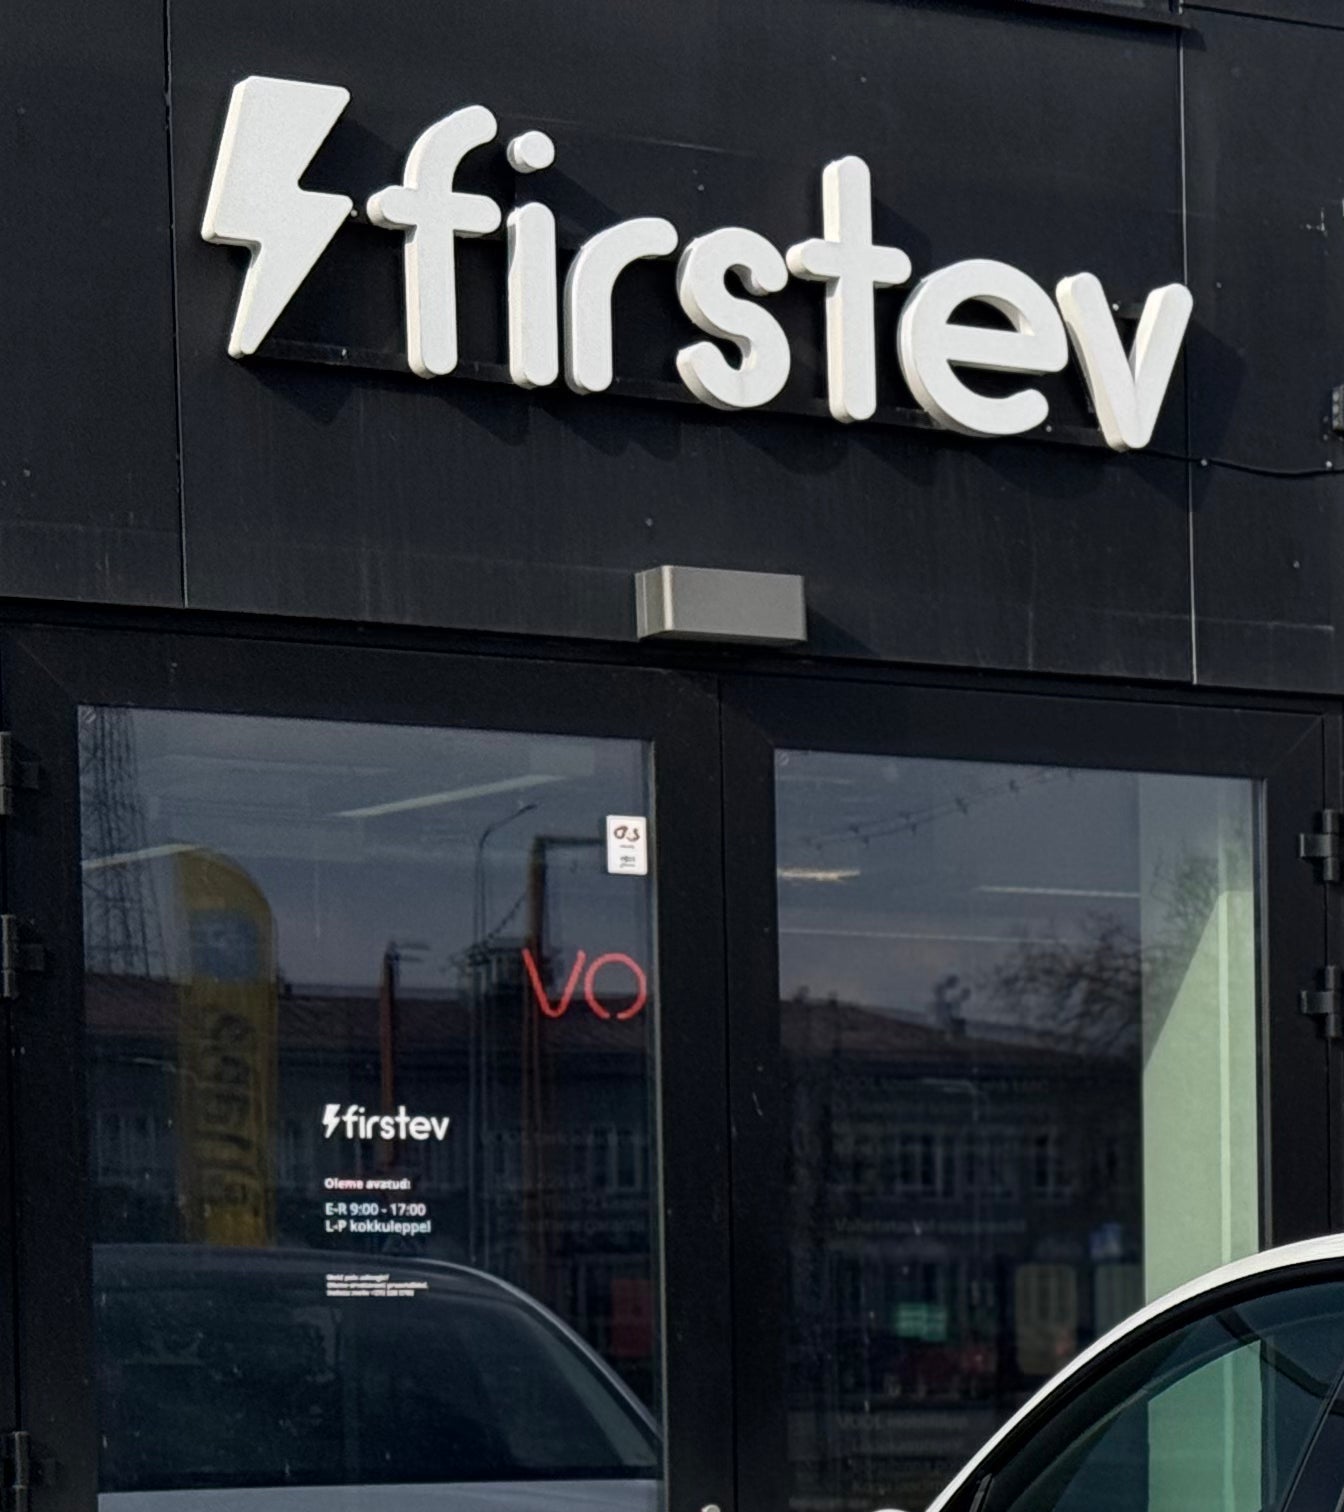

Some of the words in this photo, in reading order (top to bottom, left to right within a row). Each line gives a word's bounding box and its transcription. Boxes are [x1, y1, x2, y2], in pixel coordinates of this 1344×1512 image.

[365, 104, 1195, 452] firstev
[341, 1104, 450, 1140] firstev
[325, 1202, 347, 1216] E-R
[349, 1202, 379, 1216] 9:00
[390, 1203, 427, 1216] 17:00
[325, 1220, 347, 1233] L-P
